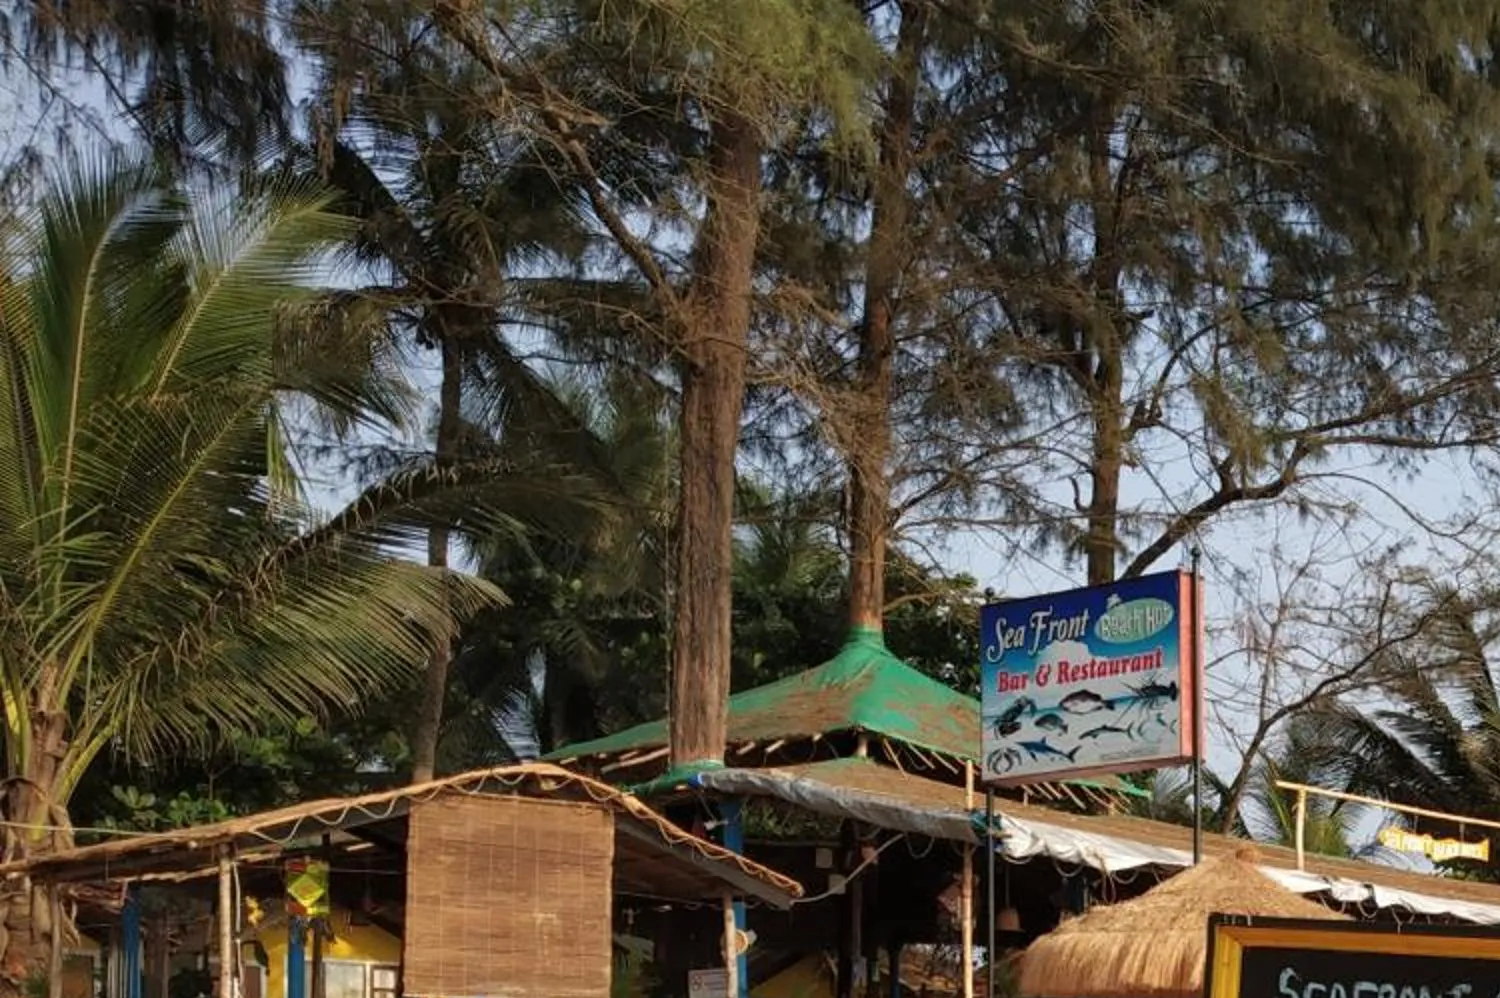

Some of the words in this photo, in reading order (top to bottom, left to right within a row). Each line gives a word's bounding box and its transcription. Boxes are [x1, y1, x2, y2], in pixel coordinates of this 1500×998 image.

[987, 616, 1026, 663] Sea
[1028, 606, 1090, 656] Front
[997, 671, 1028, 692] Bar
[1035, 663, 1051, 688] &
[1057, 646, 1163, 684] Restaurant
